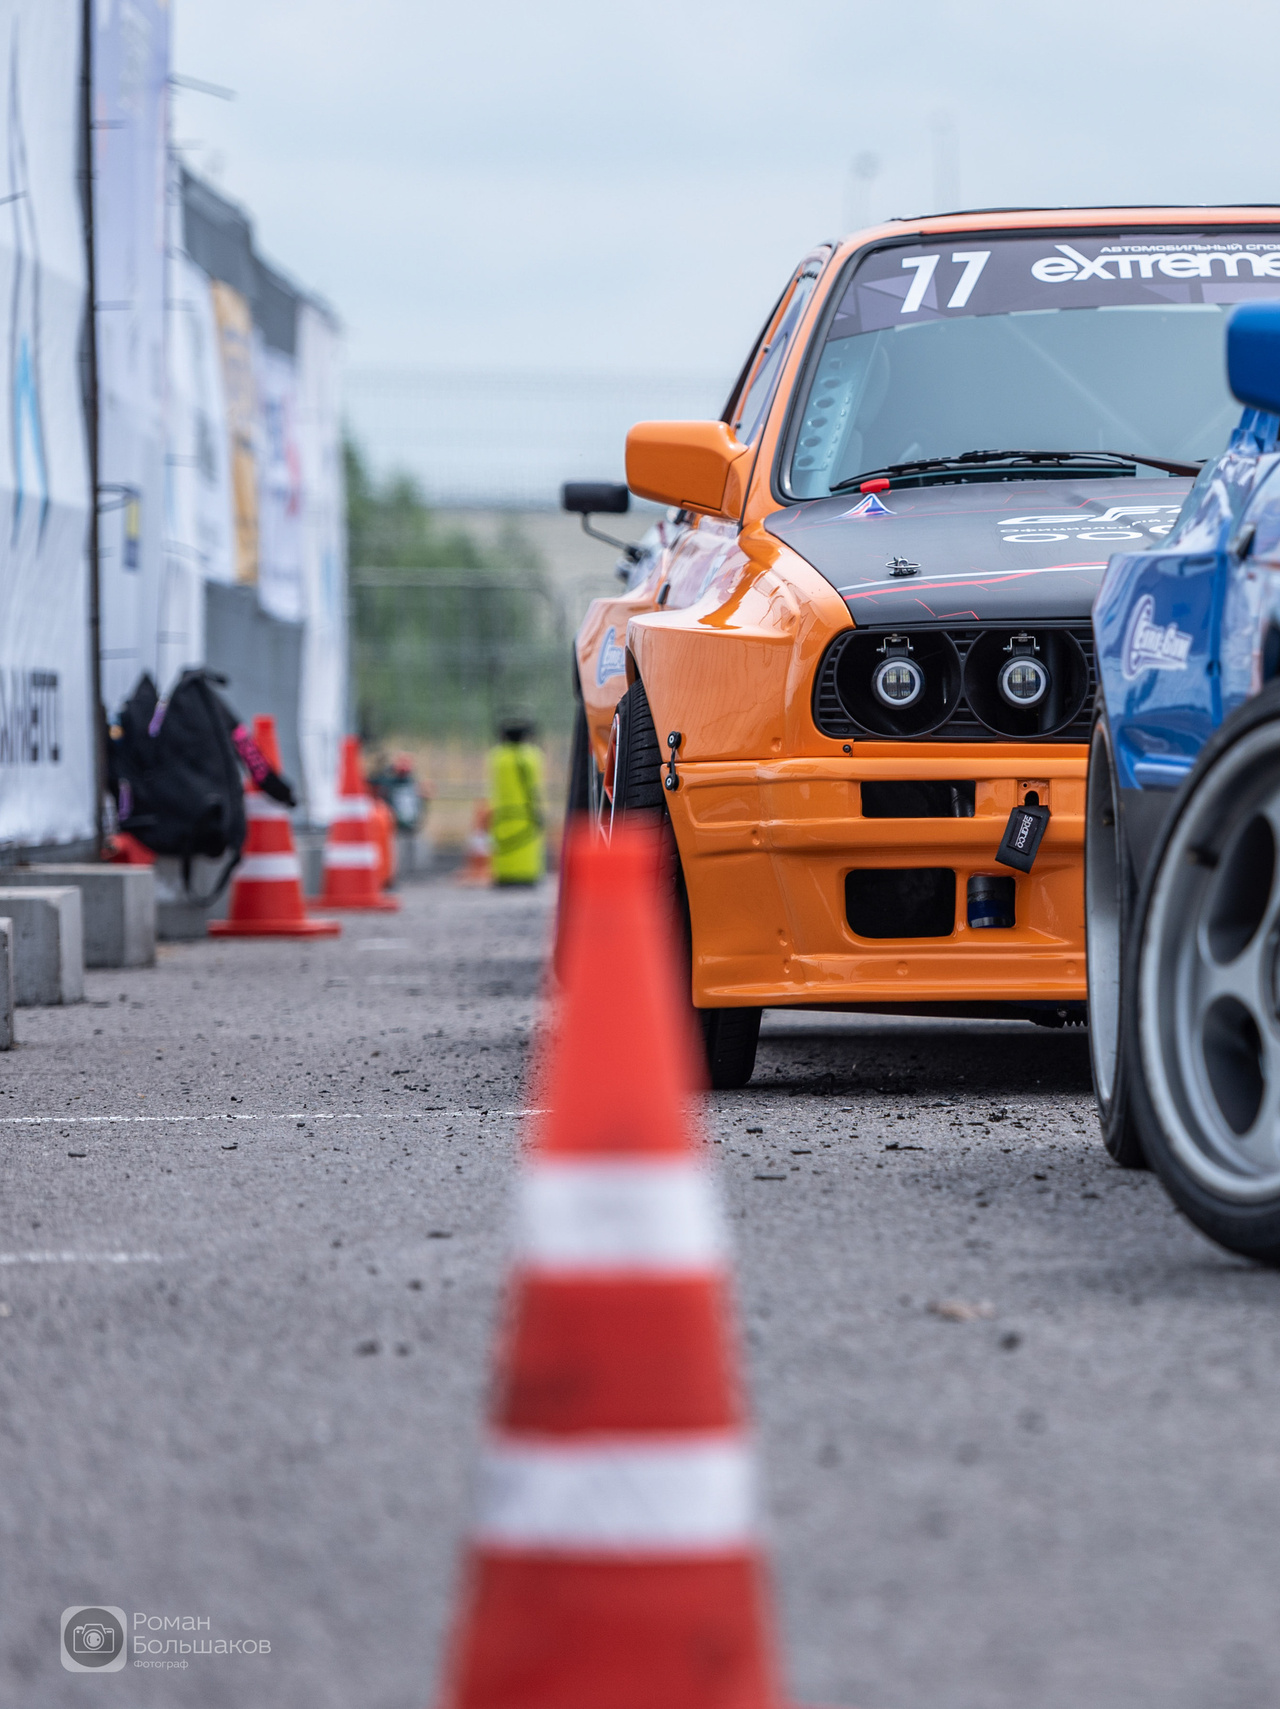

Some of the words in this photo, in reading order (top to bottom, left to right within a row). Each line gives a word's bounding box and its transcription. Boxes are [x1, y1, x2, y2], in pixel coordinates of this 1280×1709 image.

[1100, 243, 1242, 253] АВТОМОБИЛЬНЫЙ
[900, 250, 992, 314] 77
[1015, 814, 1033, 848] sparco
